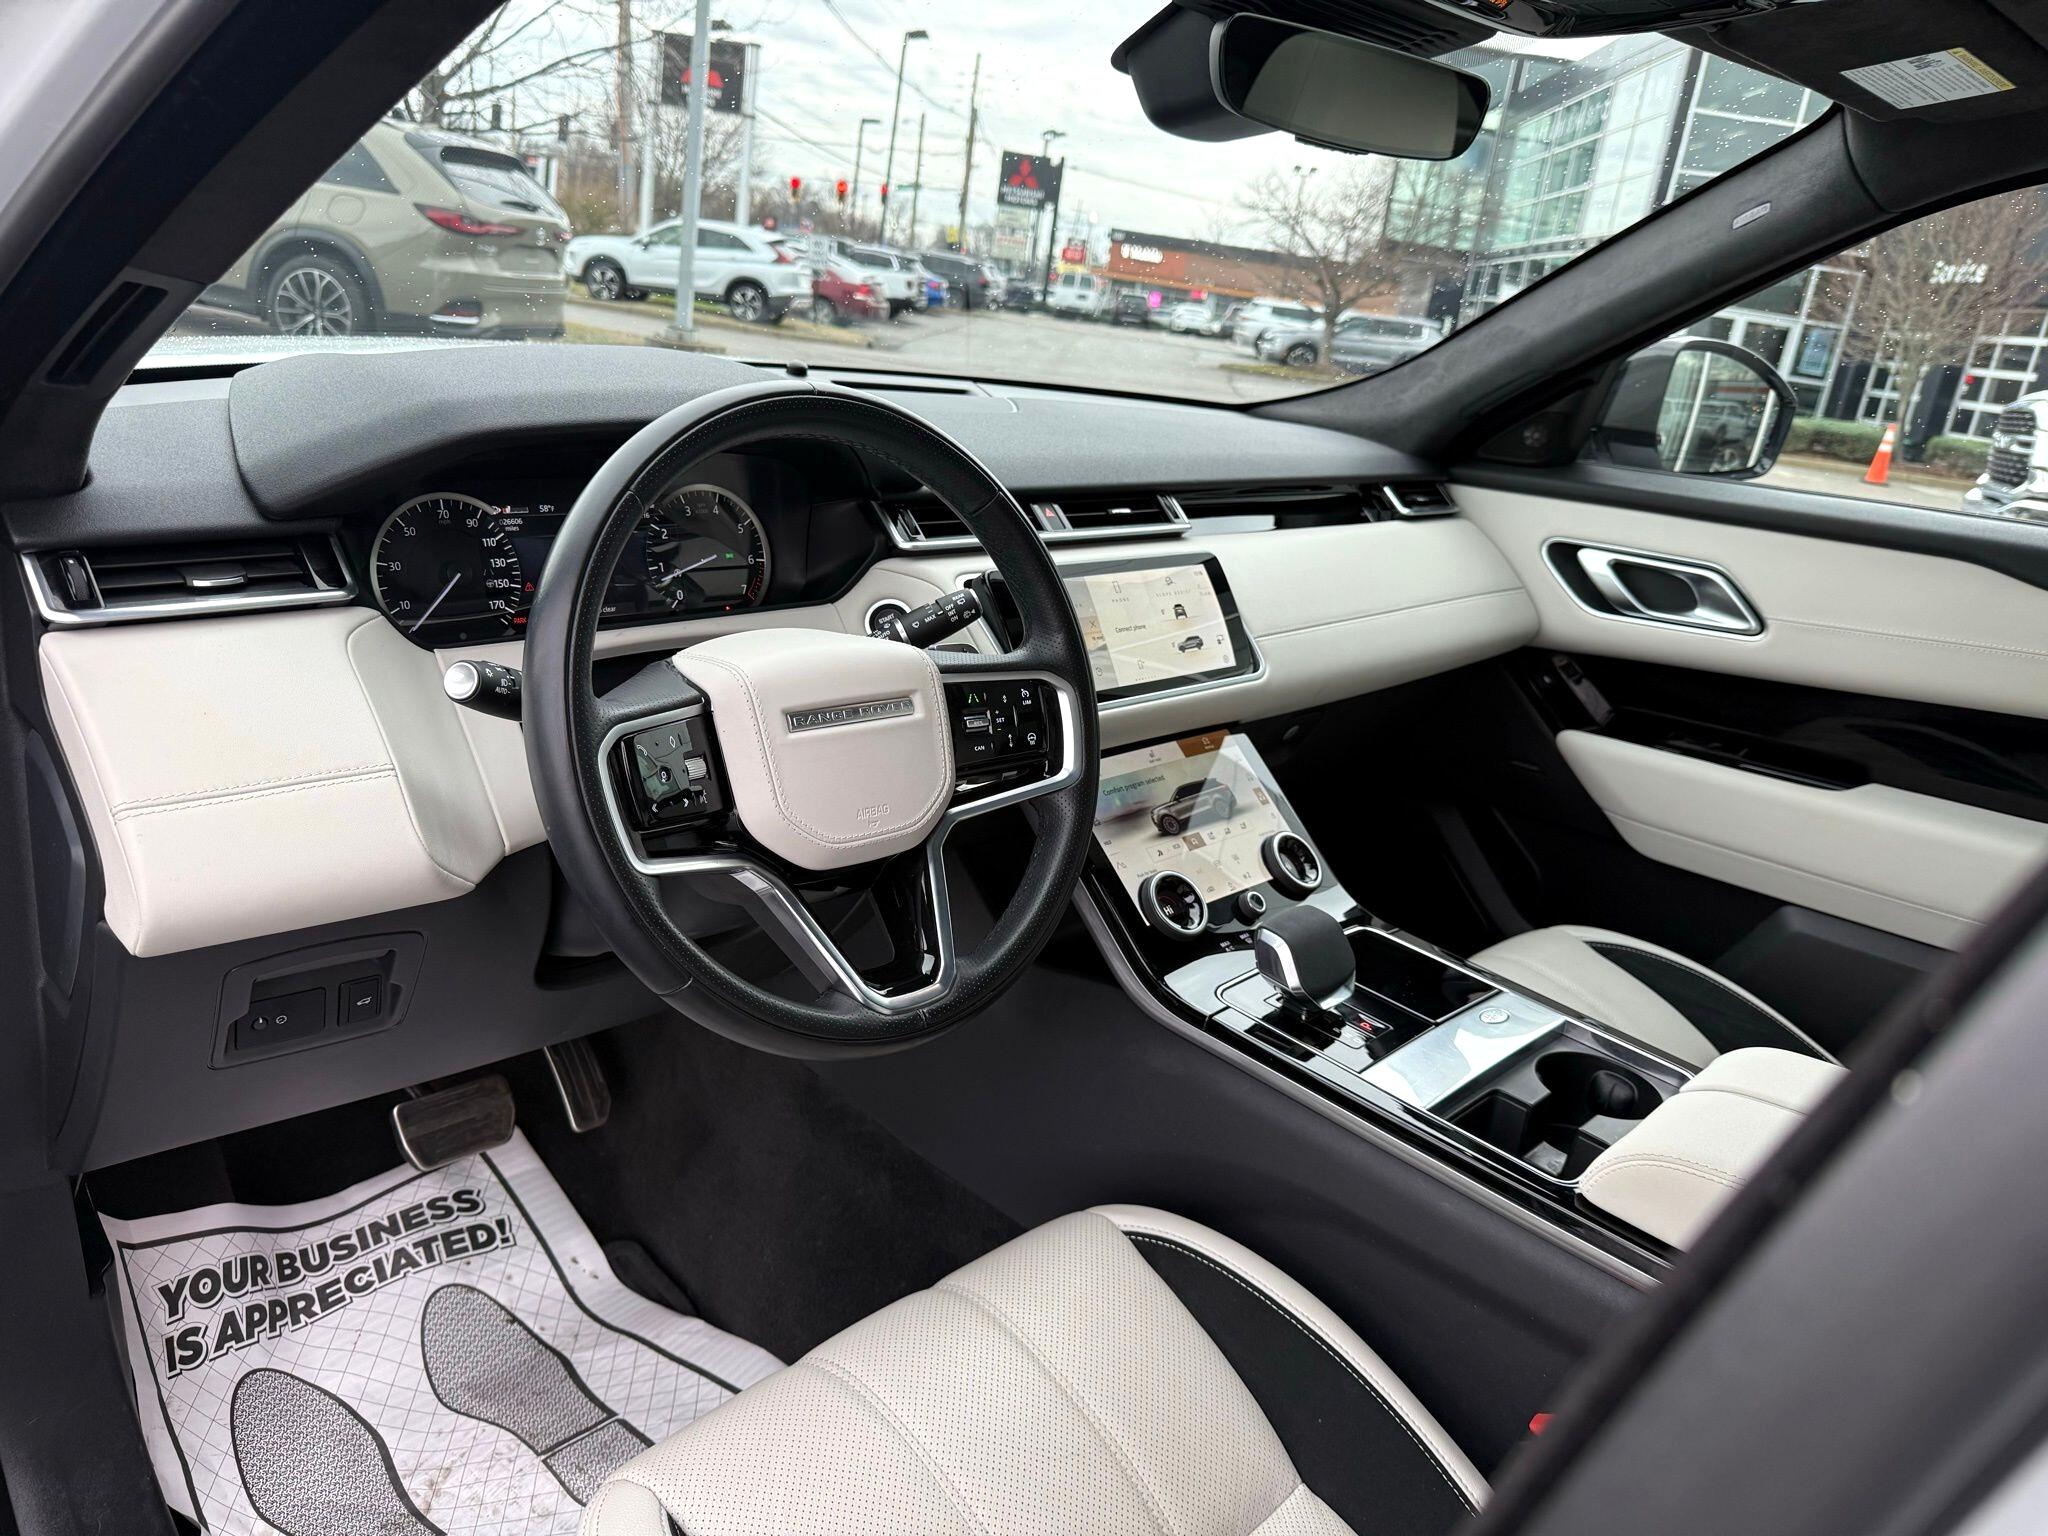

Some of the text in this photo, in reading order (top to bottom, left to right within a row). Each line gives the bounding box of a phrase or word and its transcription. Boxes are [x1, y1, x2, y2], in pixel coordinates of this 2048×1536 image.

[437, 509, 450, 519] 70
[685, 504, 692, 516] 3
[712, 503, 719, 515] 4
[466, 518, 478, 528] 90
[404, 526, 416, 536] 50
[738, 523, 744, 534] 5
[661, 528, 668, 540] 2
[482, 538, 497, 547] 110
[490, 558, 506, 568] 130
[748, 554, 755, 564] 6
[389, 561, 401, 571] 30
[659, 562, 665, 572] 1
[493, 579, 510, 588] 150
[676, 589, 684, 600] 0
[741, 584, 747, 595] 7
[400, 600, 411, 610] 10
[489, 600, 505, 609] 170
[948, 609, 957, 617] INT
[878, 613, 895, 624] START
[924, 614, 936, 623] MAX
[1115, 624, 1147, 633] Connect phone
[495, 686, 508, 695] AUTO
[793, 700, 913, 726] RANGE ROVER
[1102, 786, 1124, 796] Comfort
[1124, 781, 1146, 793] program
[856, 804, 890, 820] AIRBAG
[1163, 906, 1174, 916] Hi
[1360, 1022, 1372, 1030] P
[157, 1187, 484, 1321] YOUR BUSINESS
[163, 1215, 516, 1378] IS APPRECIATED!
